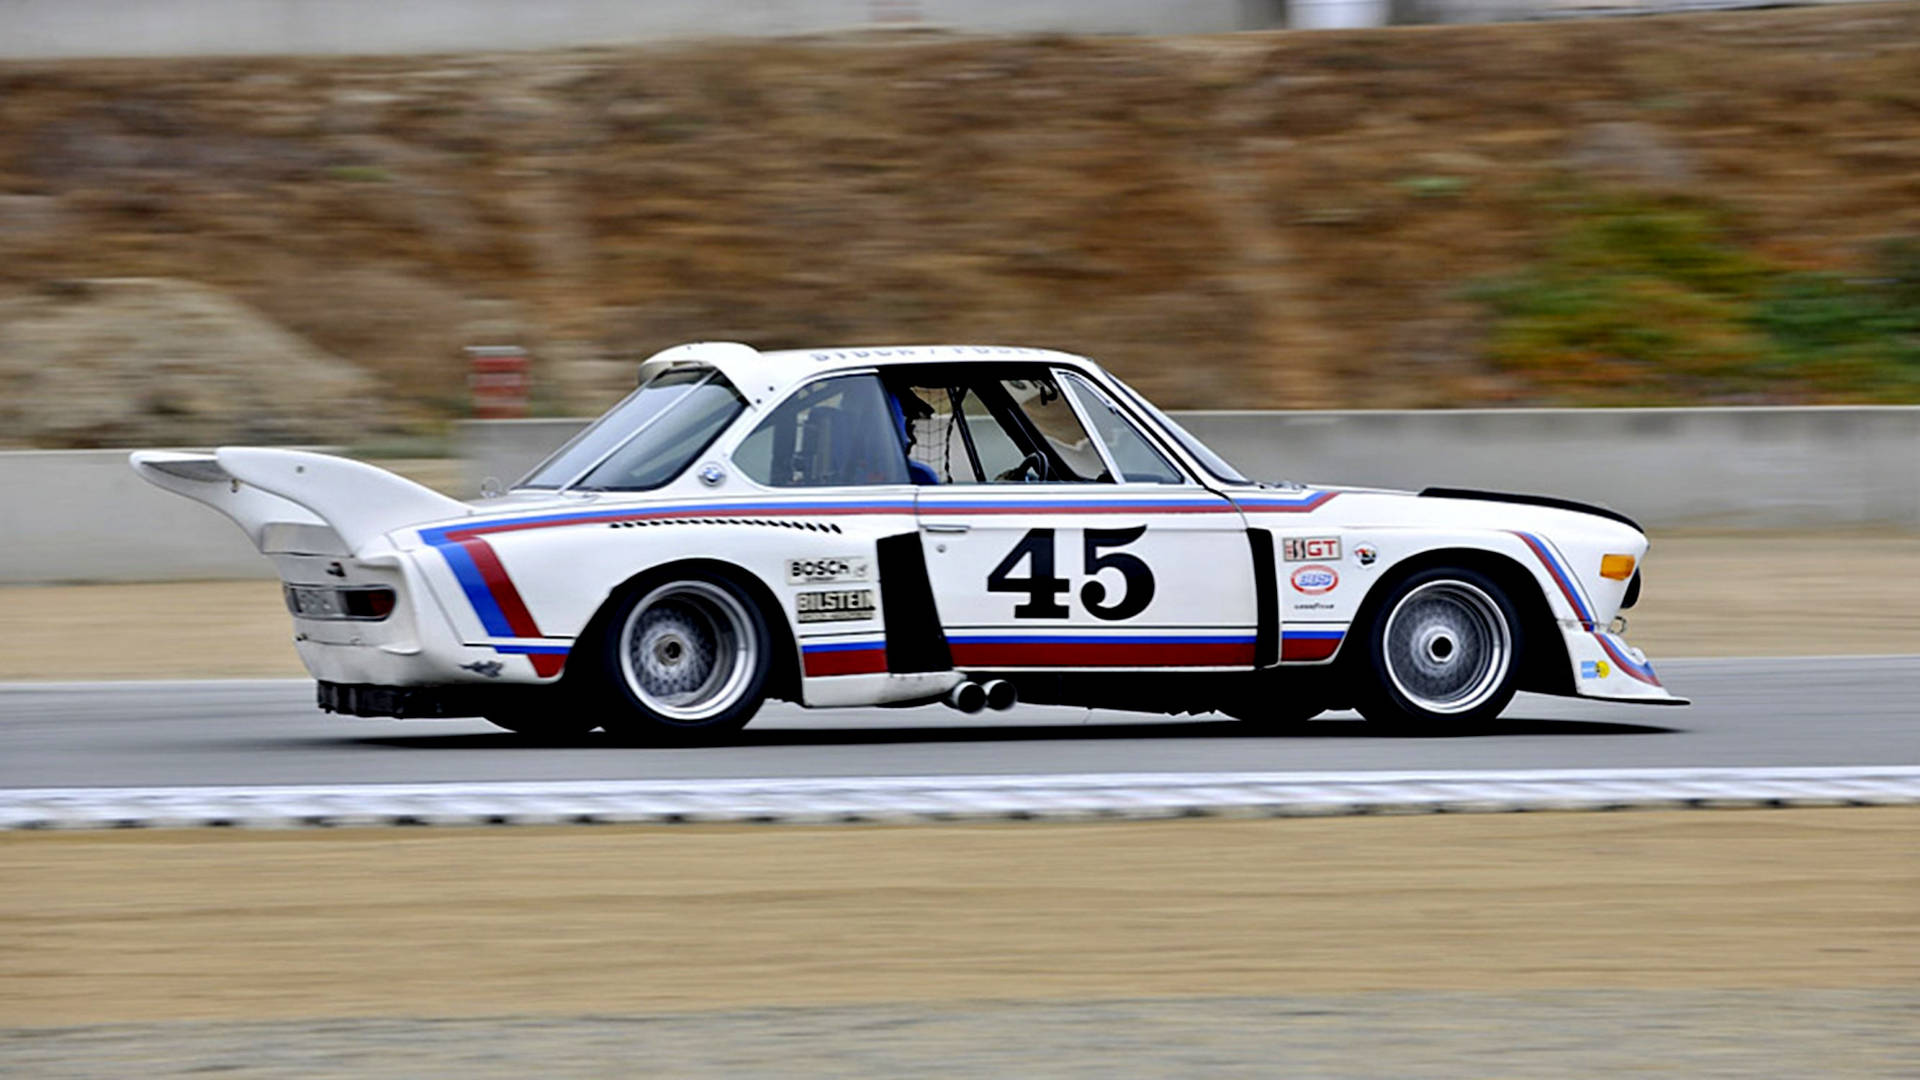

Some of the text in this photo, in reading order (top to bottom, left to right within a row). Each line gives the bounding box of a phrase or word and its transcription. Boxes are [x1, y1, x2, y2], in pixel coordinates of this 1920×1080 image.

[1307, 540, 1337, 557] GT
[792, 560, 849, 577] BOSCH
[987, 524, 1156, 621] 45
[797, 591, 875, 611] BILSTEIN
